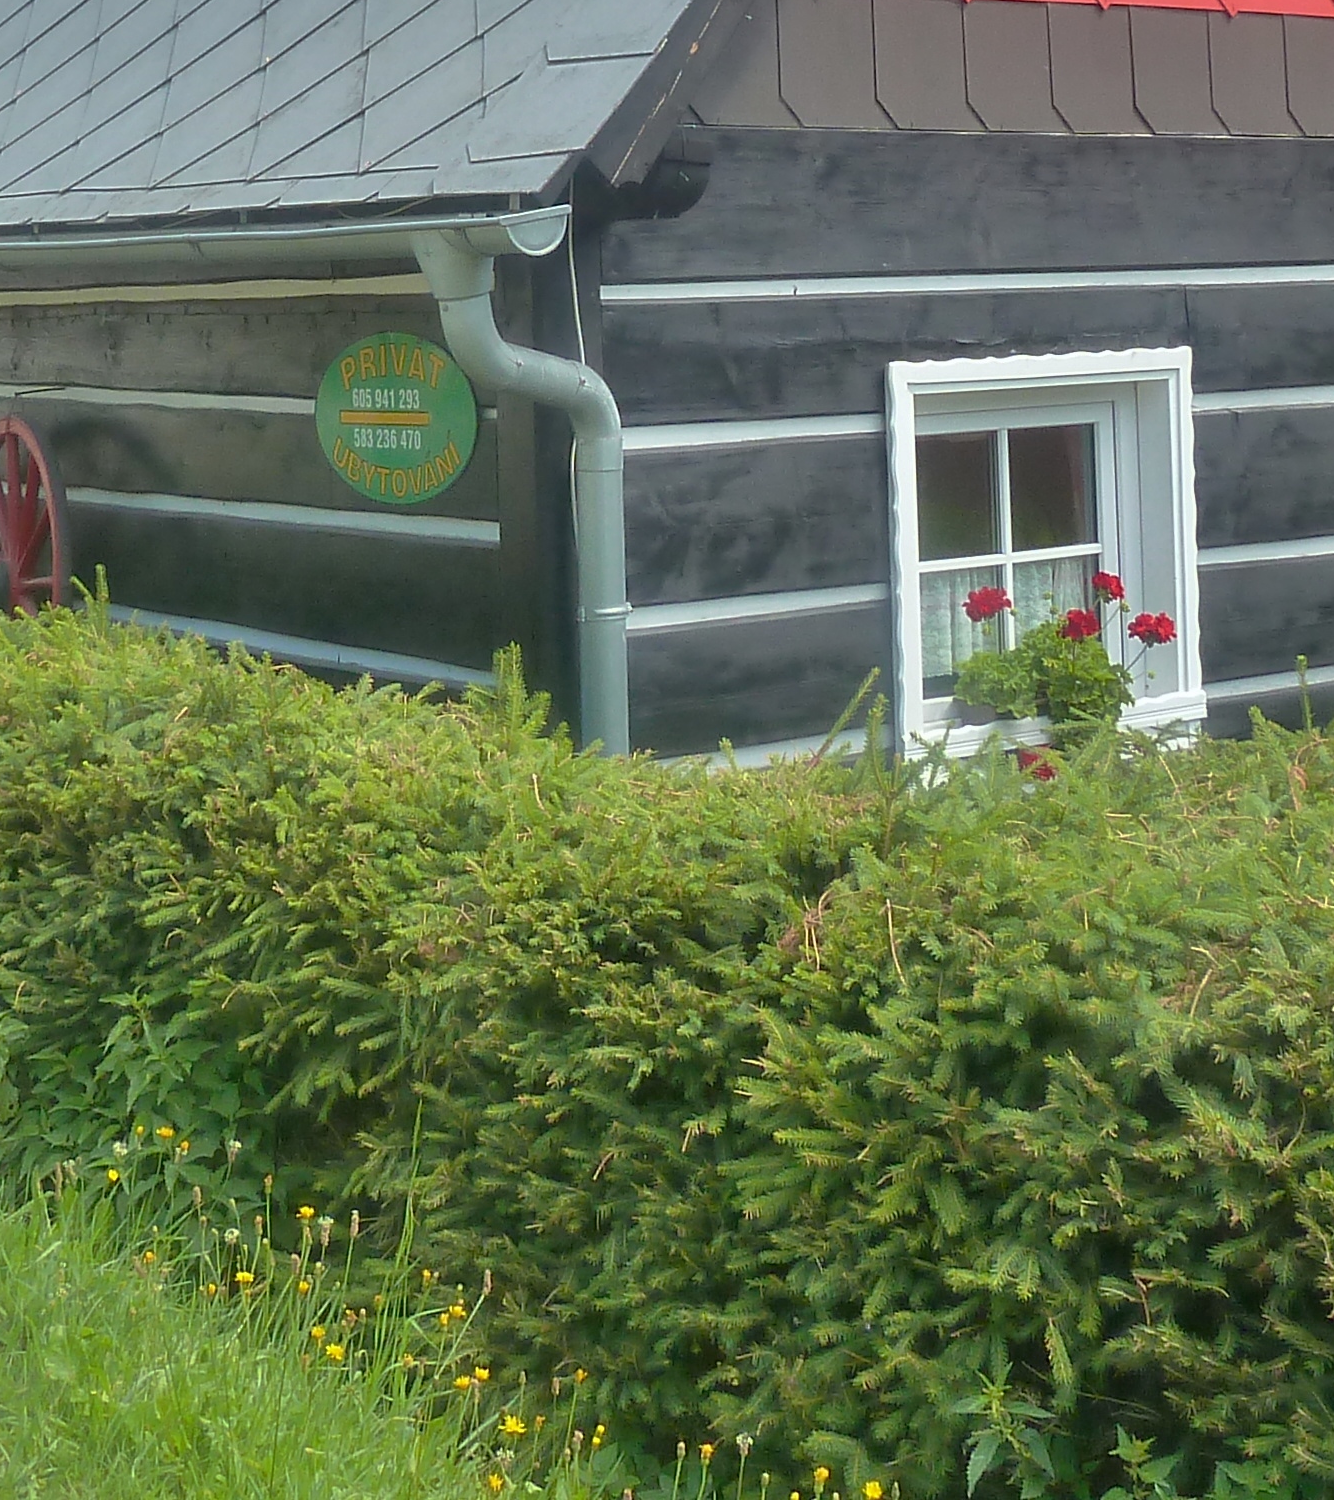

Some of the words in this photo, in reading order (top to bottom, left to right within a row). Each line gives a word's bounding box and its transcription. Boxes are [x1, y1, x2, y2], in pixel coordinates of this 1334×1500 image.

[340, 343, 446, 390] PRIVAT
[352, 388, 372, 408] 605
[375, 389, 395, 408] 941
[399, 389, 420, 409] 293
[354, 428, 373, 448] 583
[376, 429, 397, 449] 236
[400, 430, 421, 450] 470
